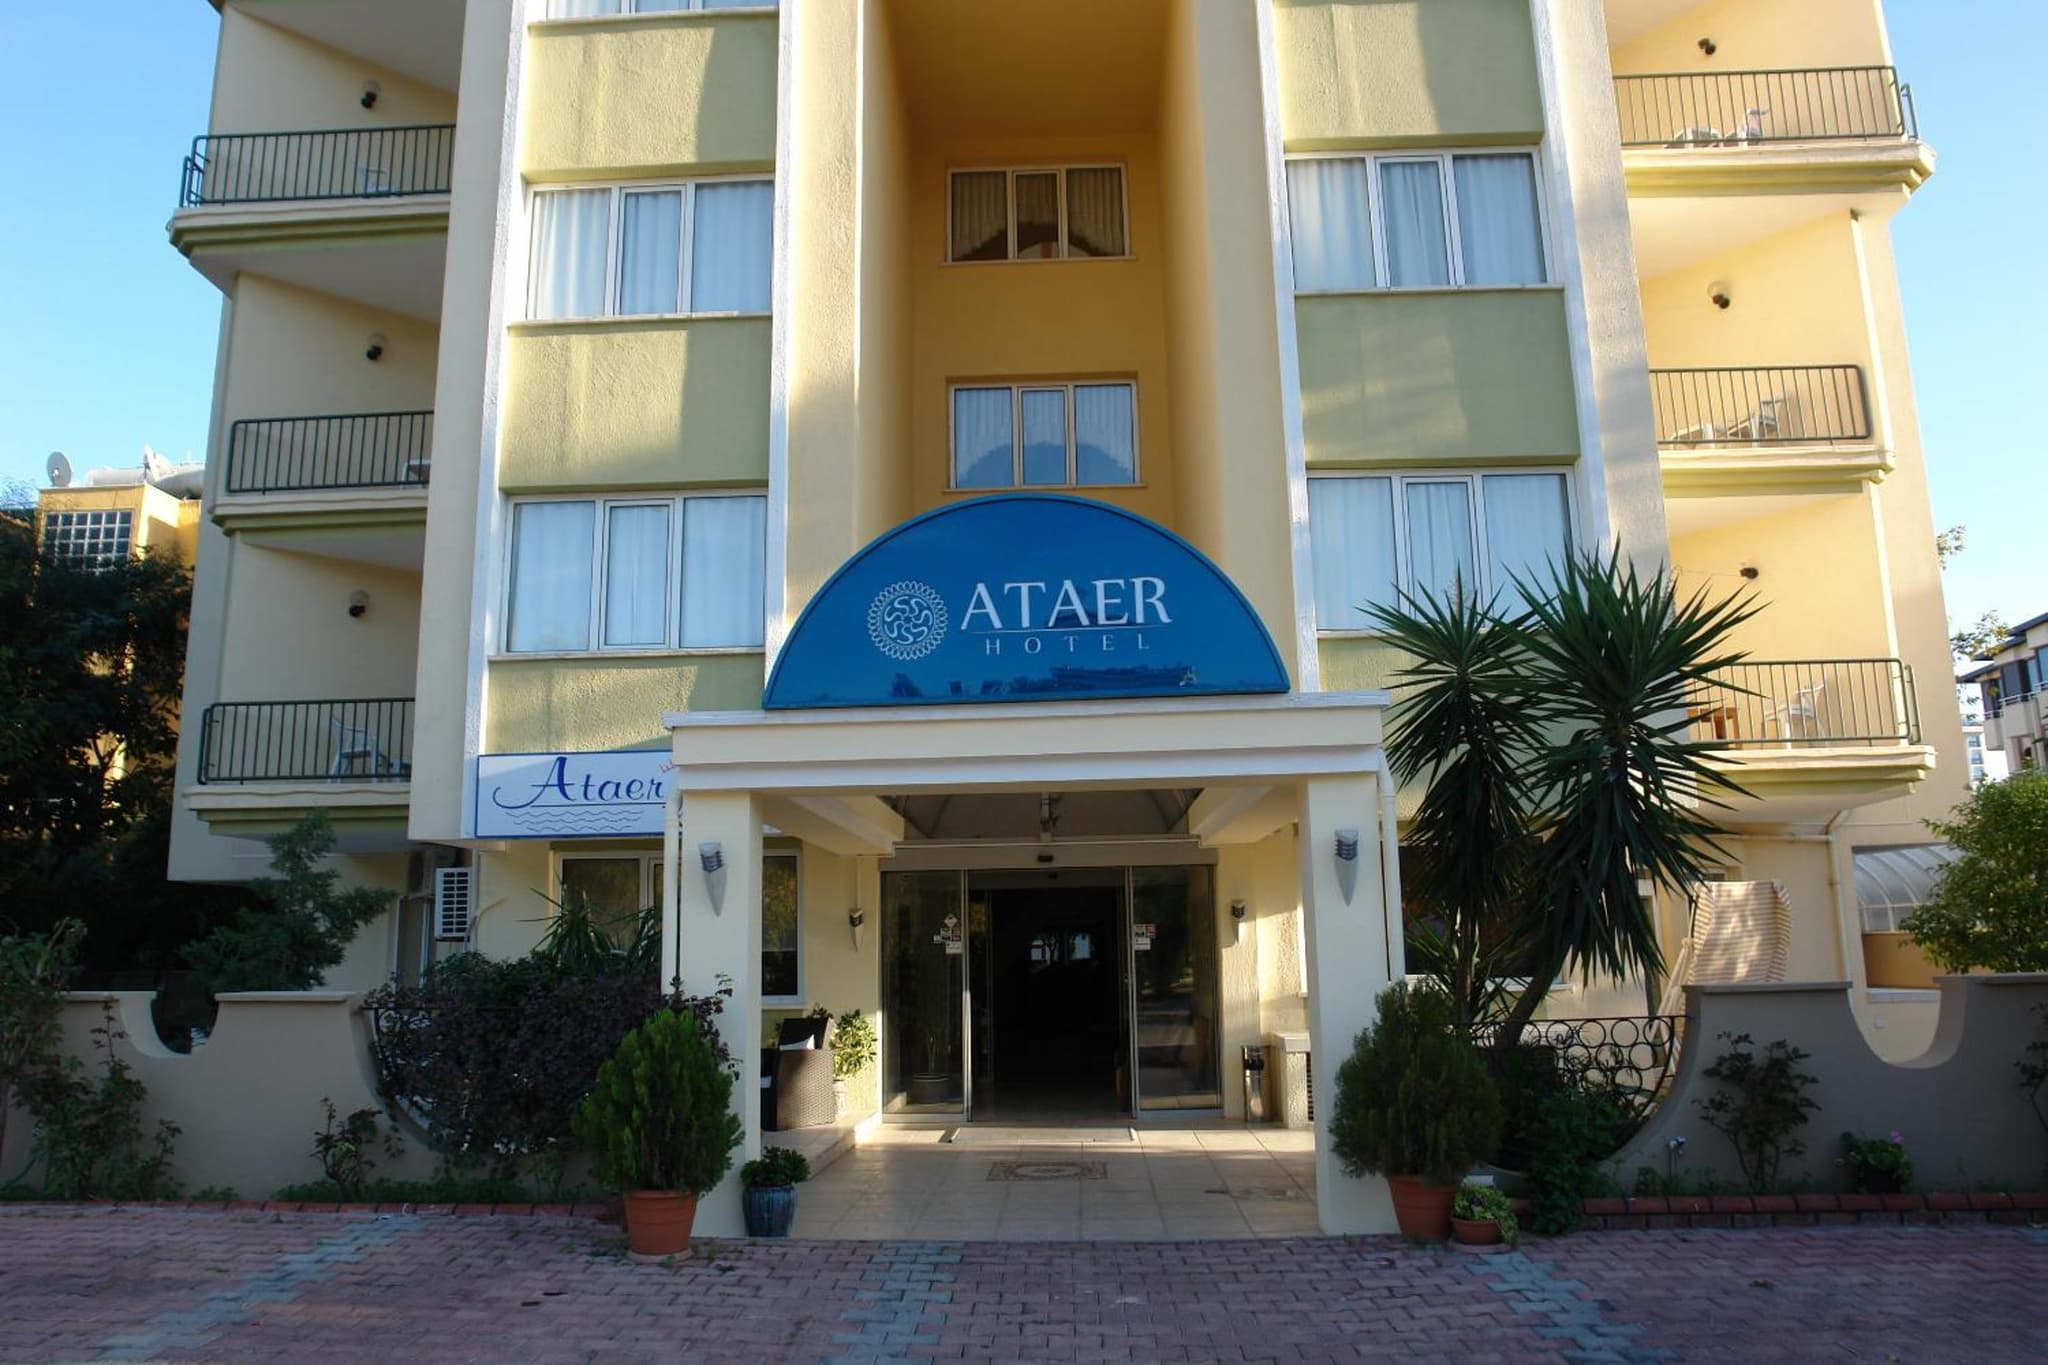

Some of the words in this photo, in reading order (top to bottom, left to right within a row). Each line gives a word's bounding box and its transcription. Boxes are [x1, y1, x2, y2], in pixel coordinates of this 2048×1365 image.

[961, 576, 1173, 630] ATAER
[986, 633, 1149, 656] HOTEL
[493, 756, 664, 809] Ataer
